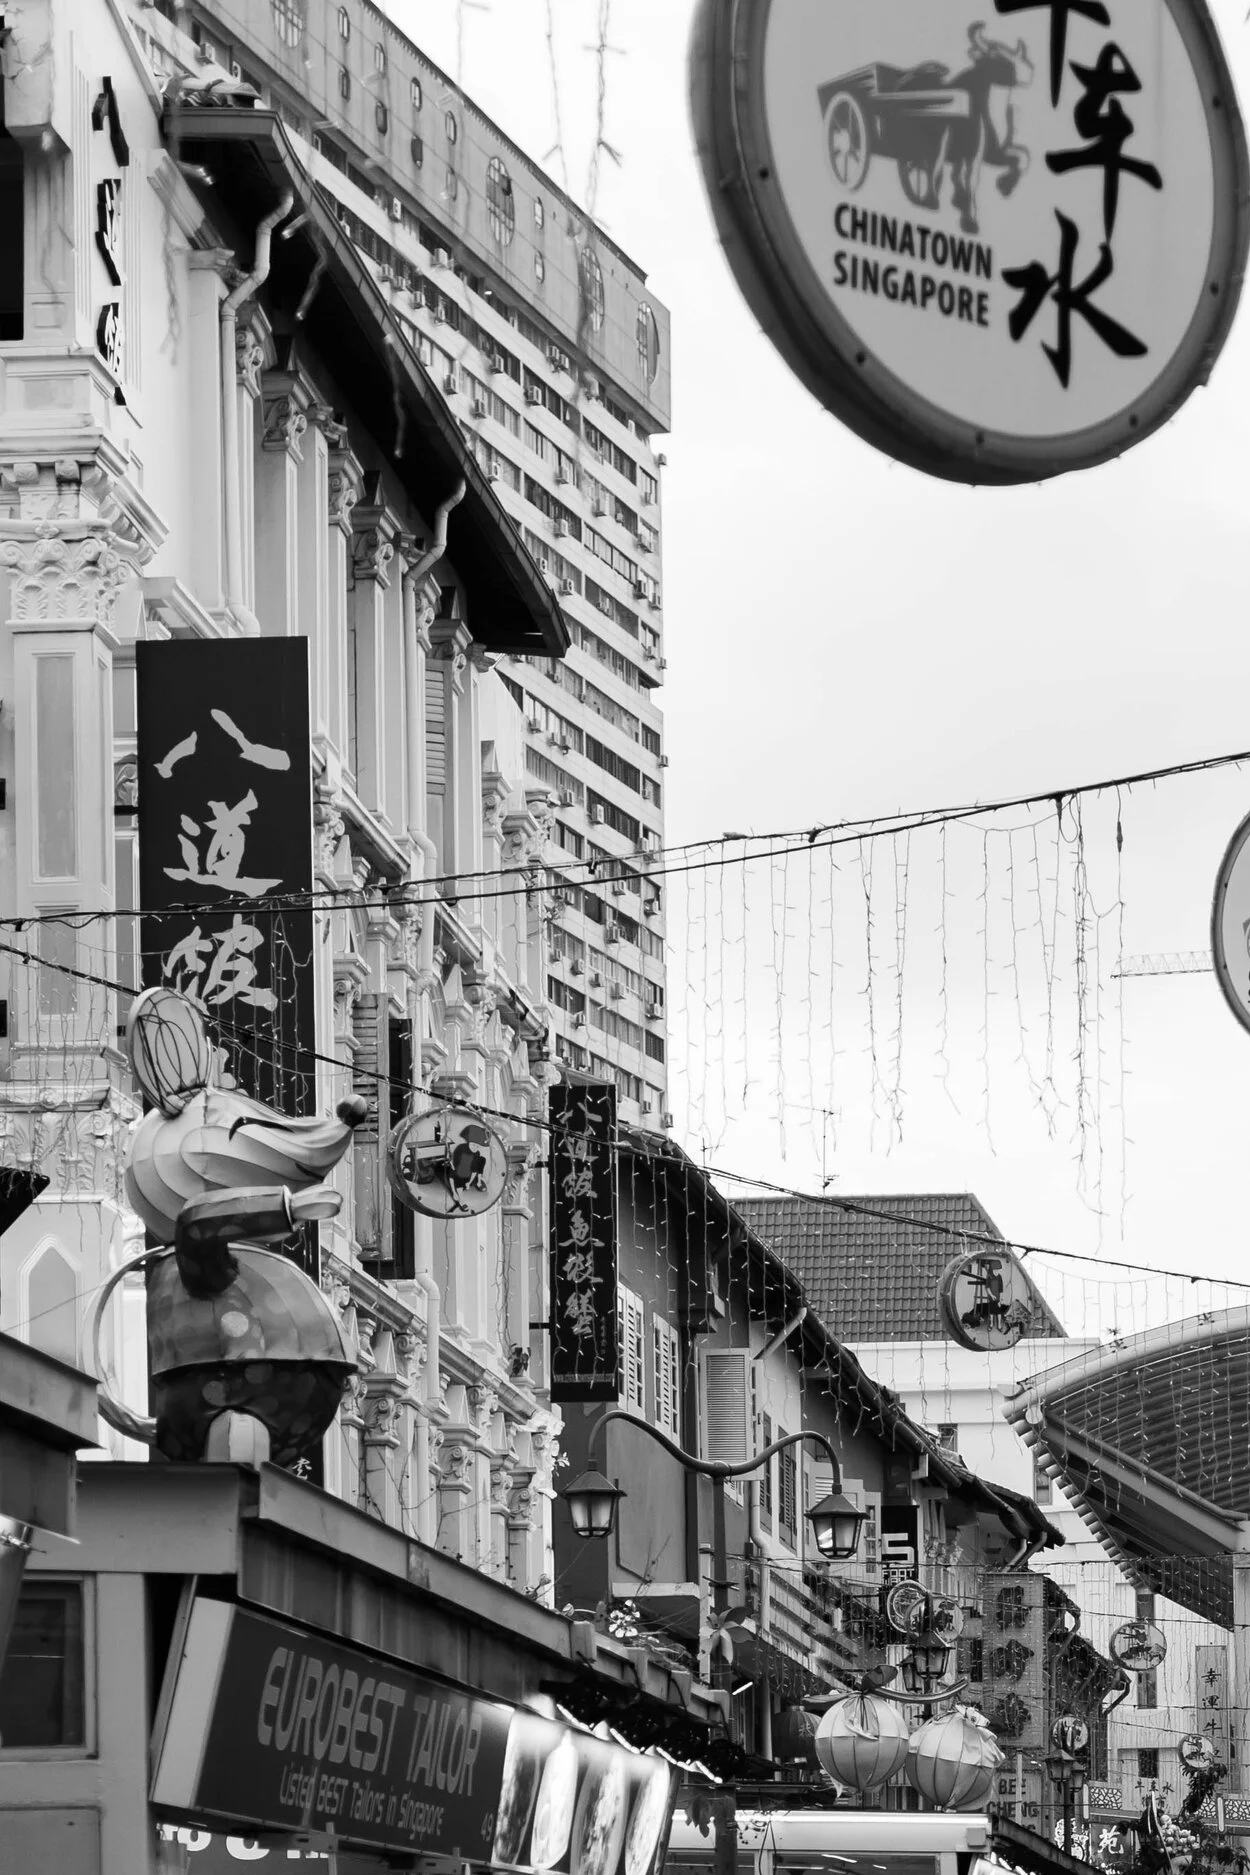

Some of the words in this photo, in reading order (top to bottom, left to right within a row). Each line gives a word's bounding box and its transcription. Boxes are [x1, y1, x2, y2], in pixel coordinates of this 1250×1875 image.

[833, 203, 993, 281] CHINATOWN
[833, 252, 990, 327] SINGAPORE
[257, 1646, 406, 1775] EUROBEST
[406, 1695, 482, 1796] TAILOR
[280, 1761, 318, 1809] Listed
[316, 1773, 349, 1816] BEST
[350, 1780, 386, 1824] Tailors
[386, 1785, 397, 1826] in
[398, 1790, 445, 1841] Singapore
